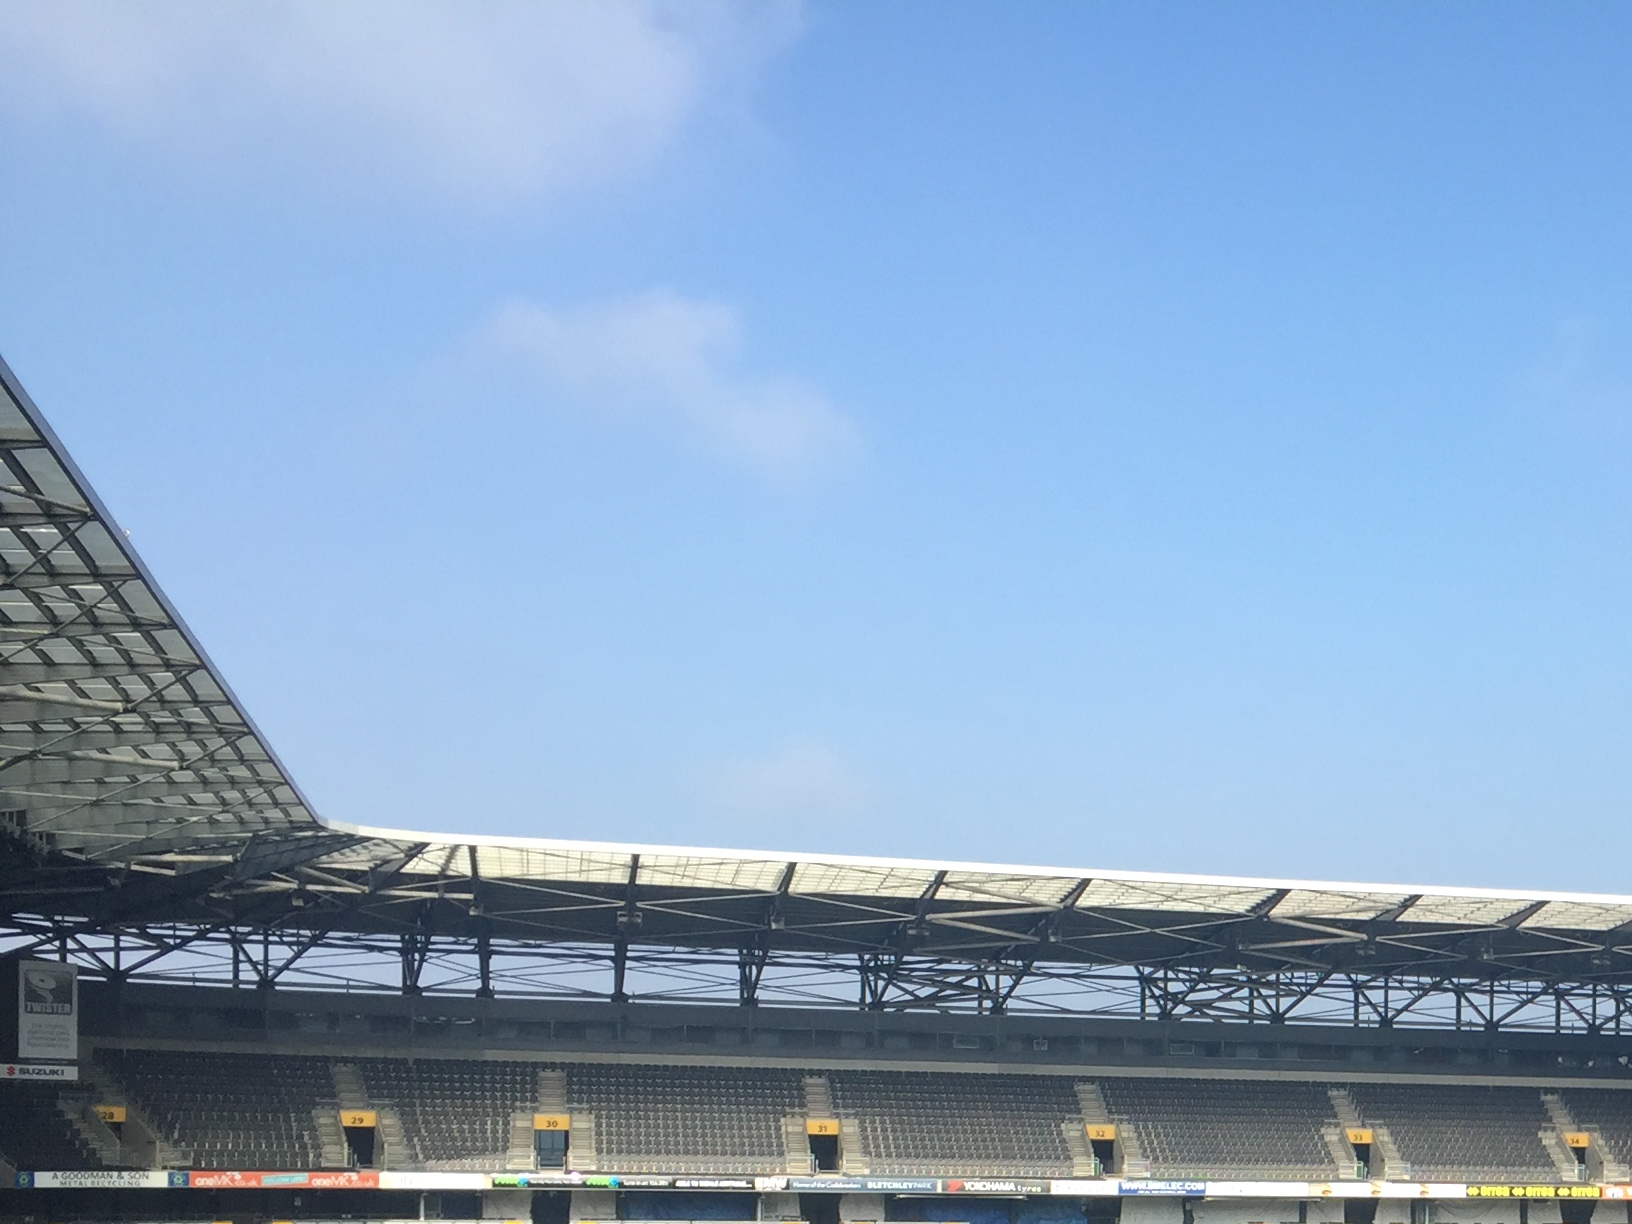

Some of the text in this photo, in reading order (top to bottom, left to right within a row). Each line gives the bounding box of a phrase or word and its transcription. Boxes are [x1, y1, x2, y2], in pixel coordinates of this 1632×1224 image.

[26, 1002, 72, 1014] TWISTER
[18, 1067, 65, 1077] SUZUKI
[351, 1117, 364, 1125] 29
[546, 1120, 558, 1128] 30
[818, 1125, 827, 1133] 31
[1095, 1129, 1106, 1138] 32
[61, 1171, 113, 1180] GOODMAN
[127, 1172, 149, 1180] SON
[964, 1181, 1042, 1193] YOKOHAMA tyres
